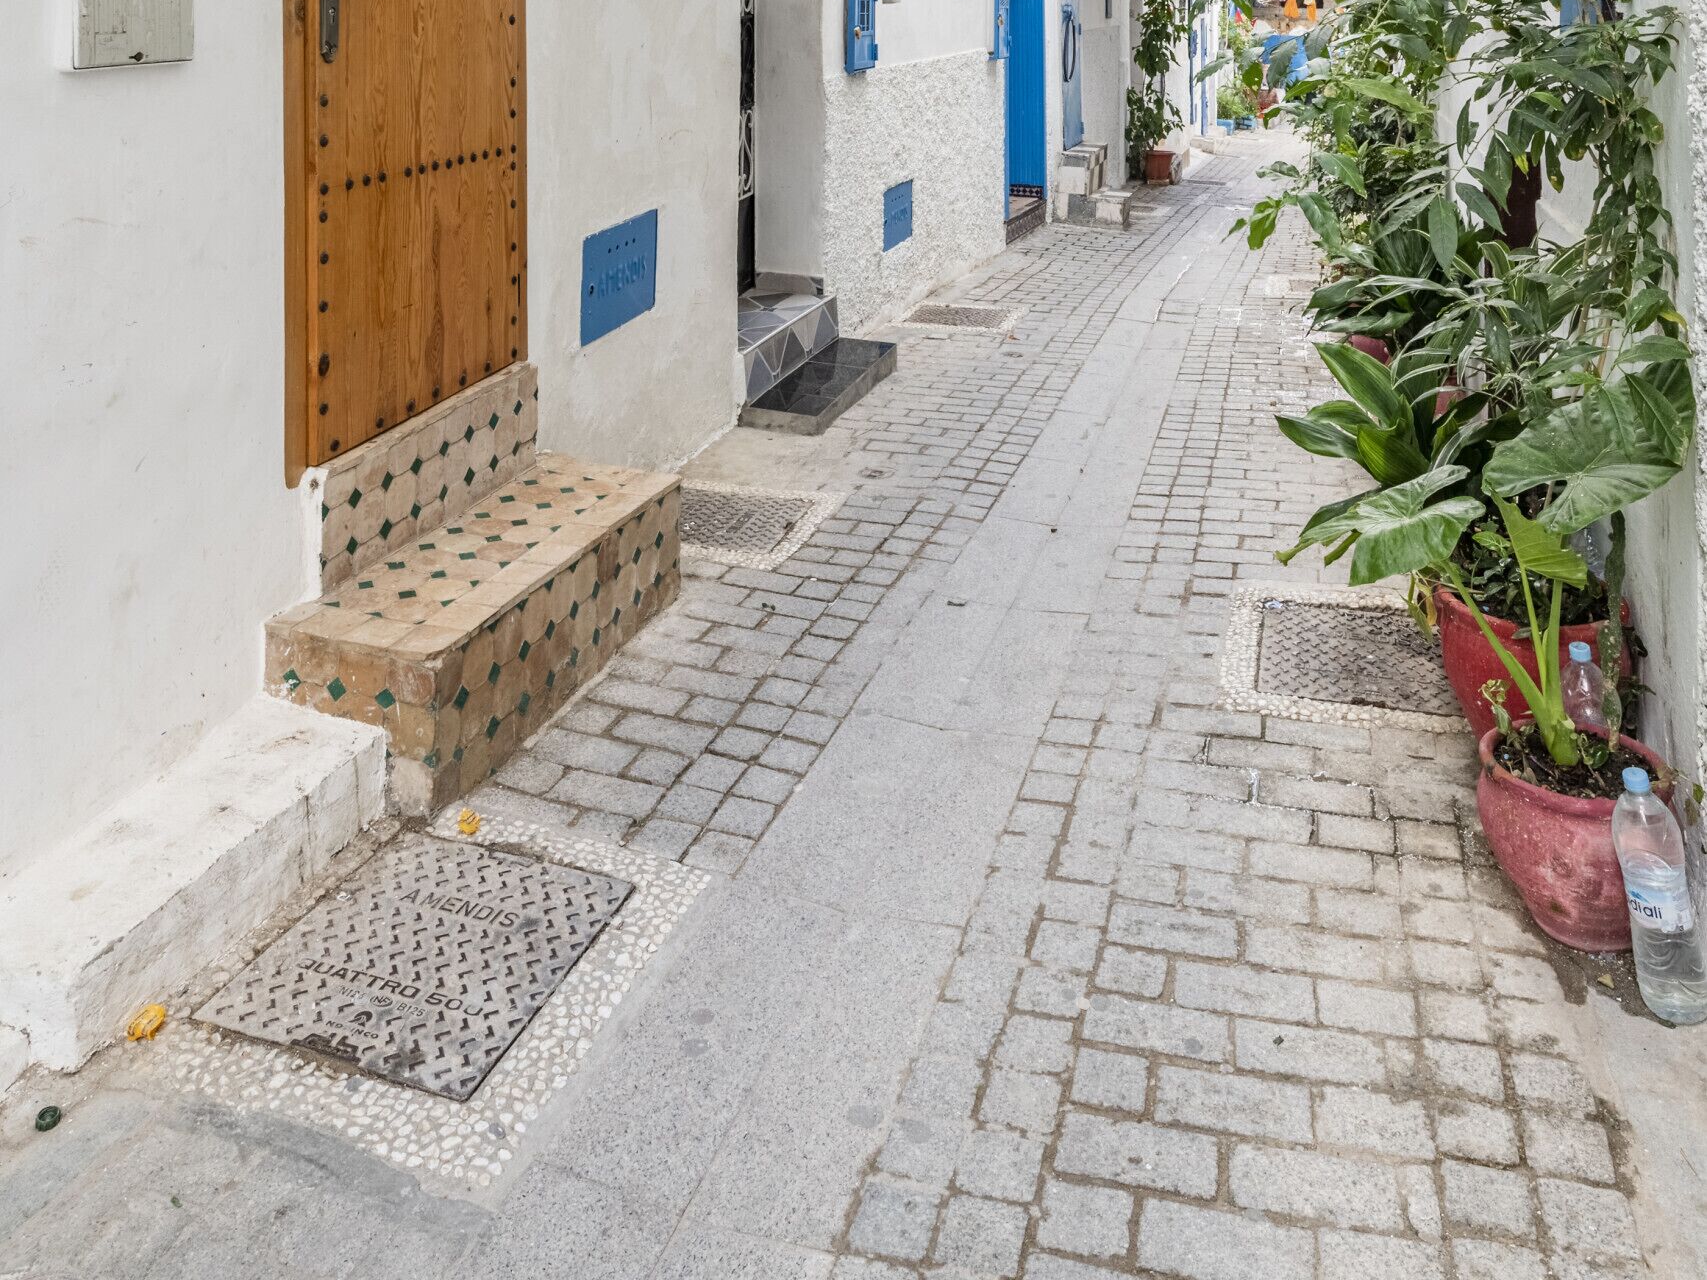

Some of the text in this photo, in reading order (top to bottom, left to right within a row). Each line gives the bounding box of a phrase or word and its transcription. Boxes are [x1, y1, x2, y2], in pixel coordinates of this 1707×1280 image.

[399, 888, 520, 927] AMENDIS
[298, 957, 421, 999] QUATTRO
[325, 1020, 379, 1039] NOINCO
